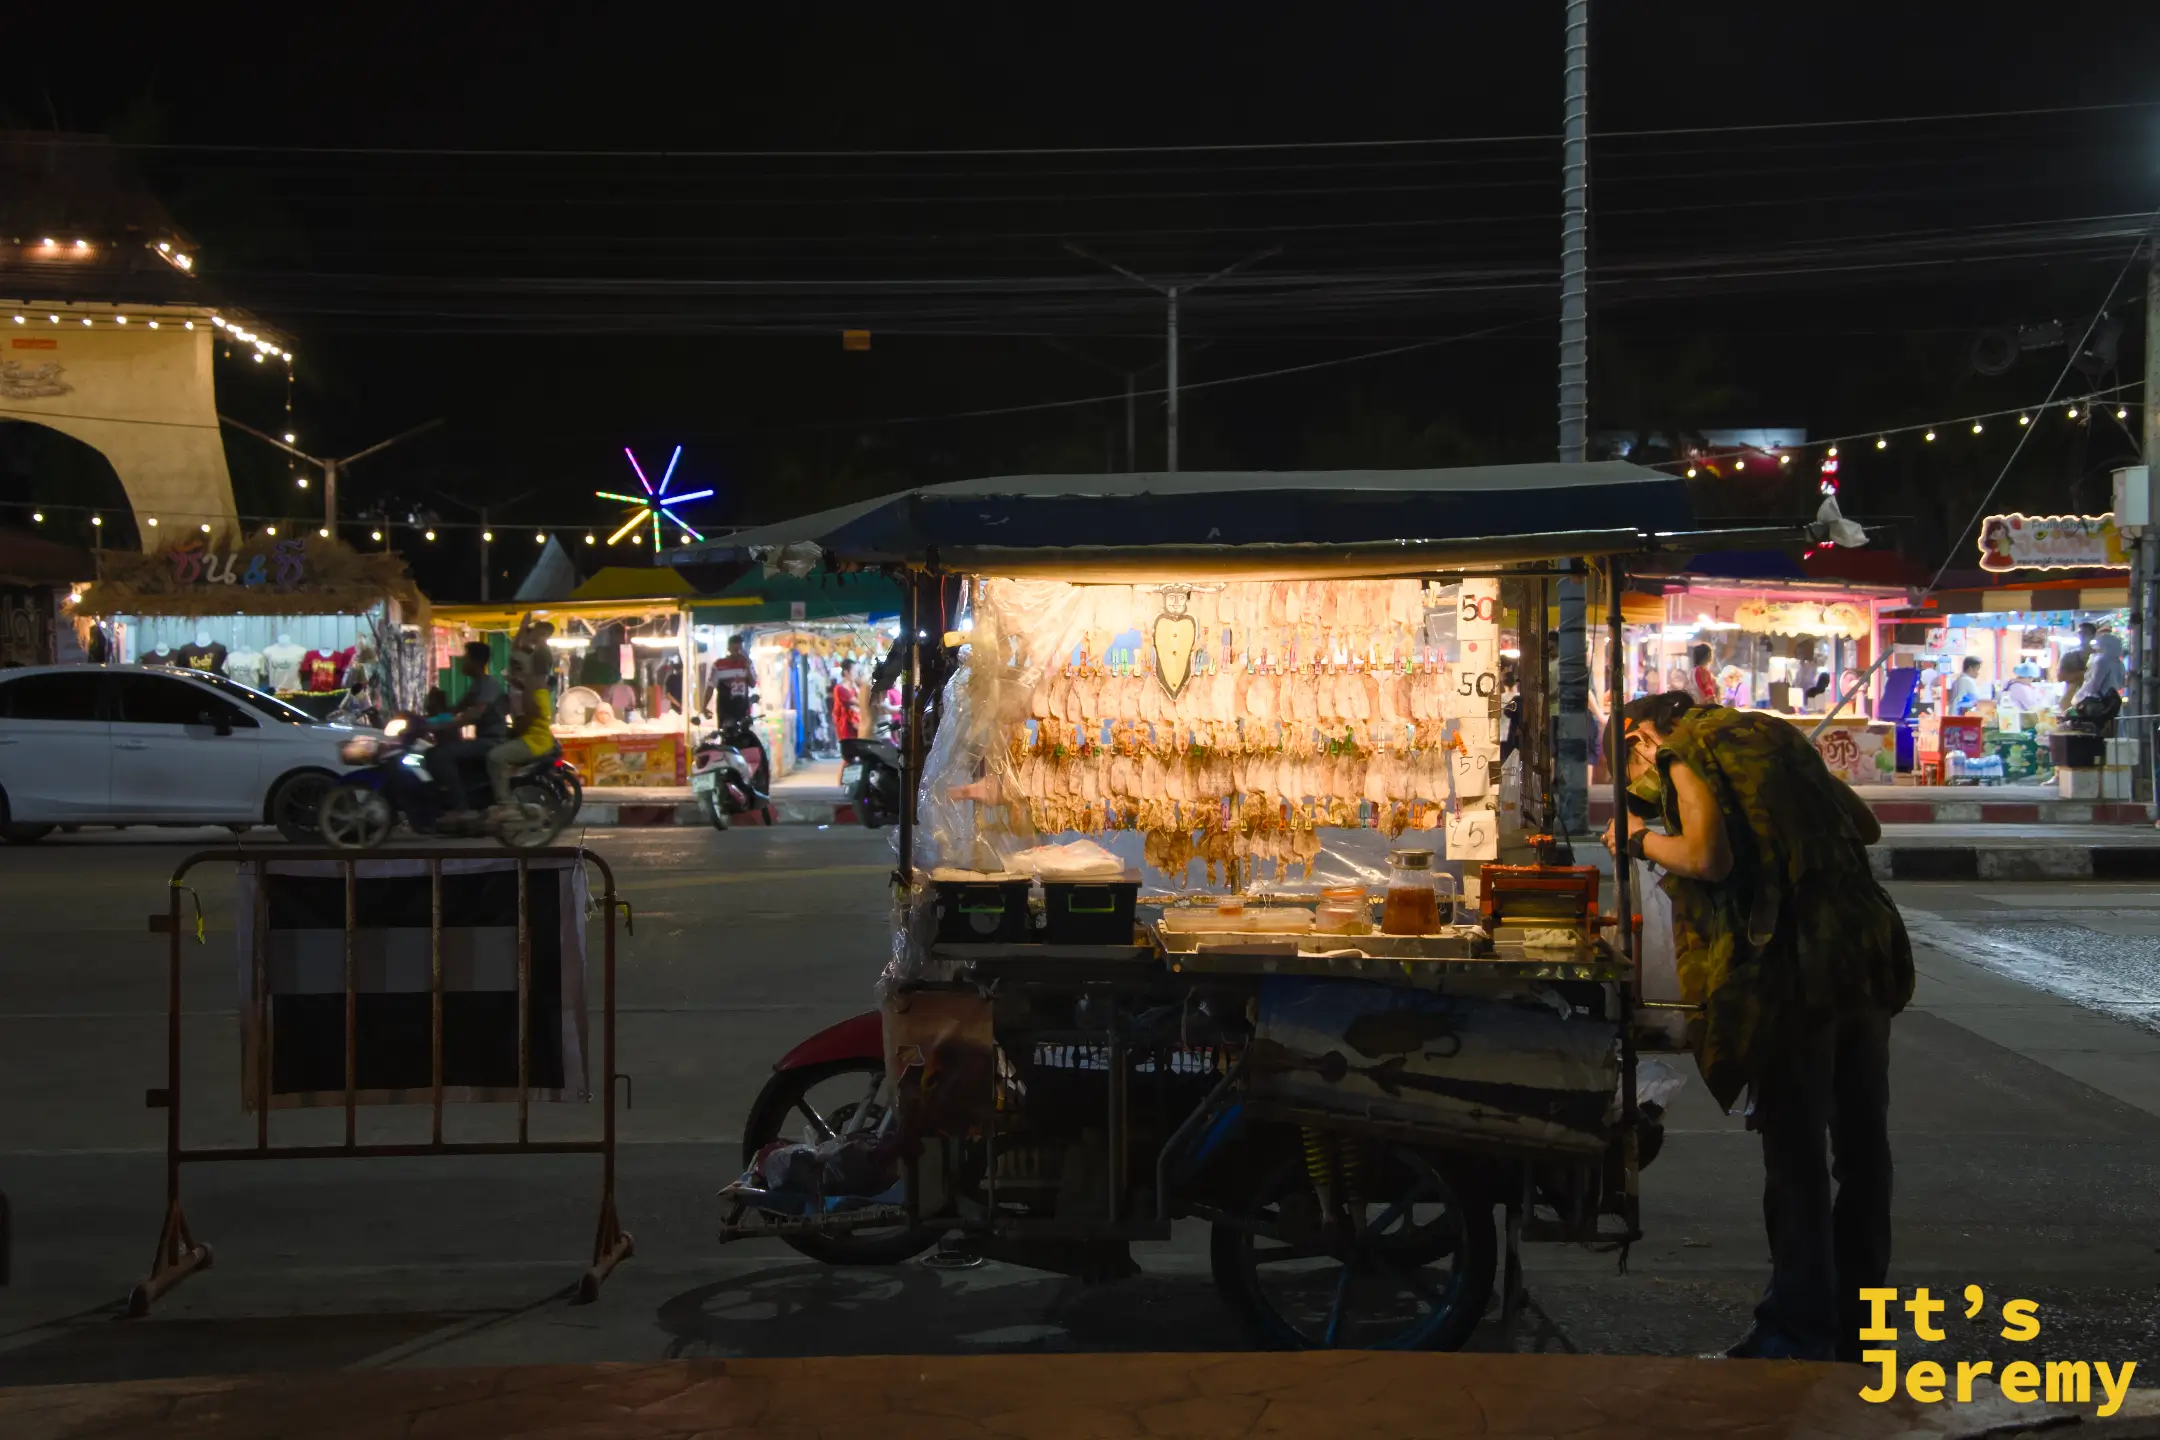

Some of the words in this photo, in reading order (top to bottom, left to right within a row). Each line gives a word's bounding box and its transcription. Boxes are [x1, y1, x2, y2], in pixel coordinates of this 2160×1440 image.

[1462, 594, 1494, 621] 50
[1457, 672, 1497, 697] 50
[1459, 754, 1488, 776] 50
